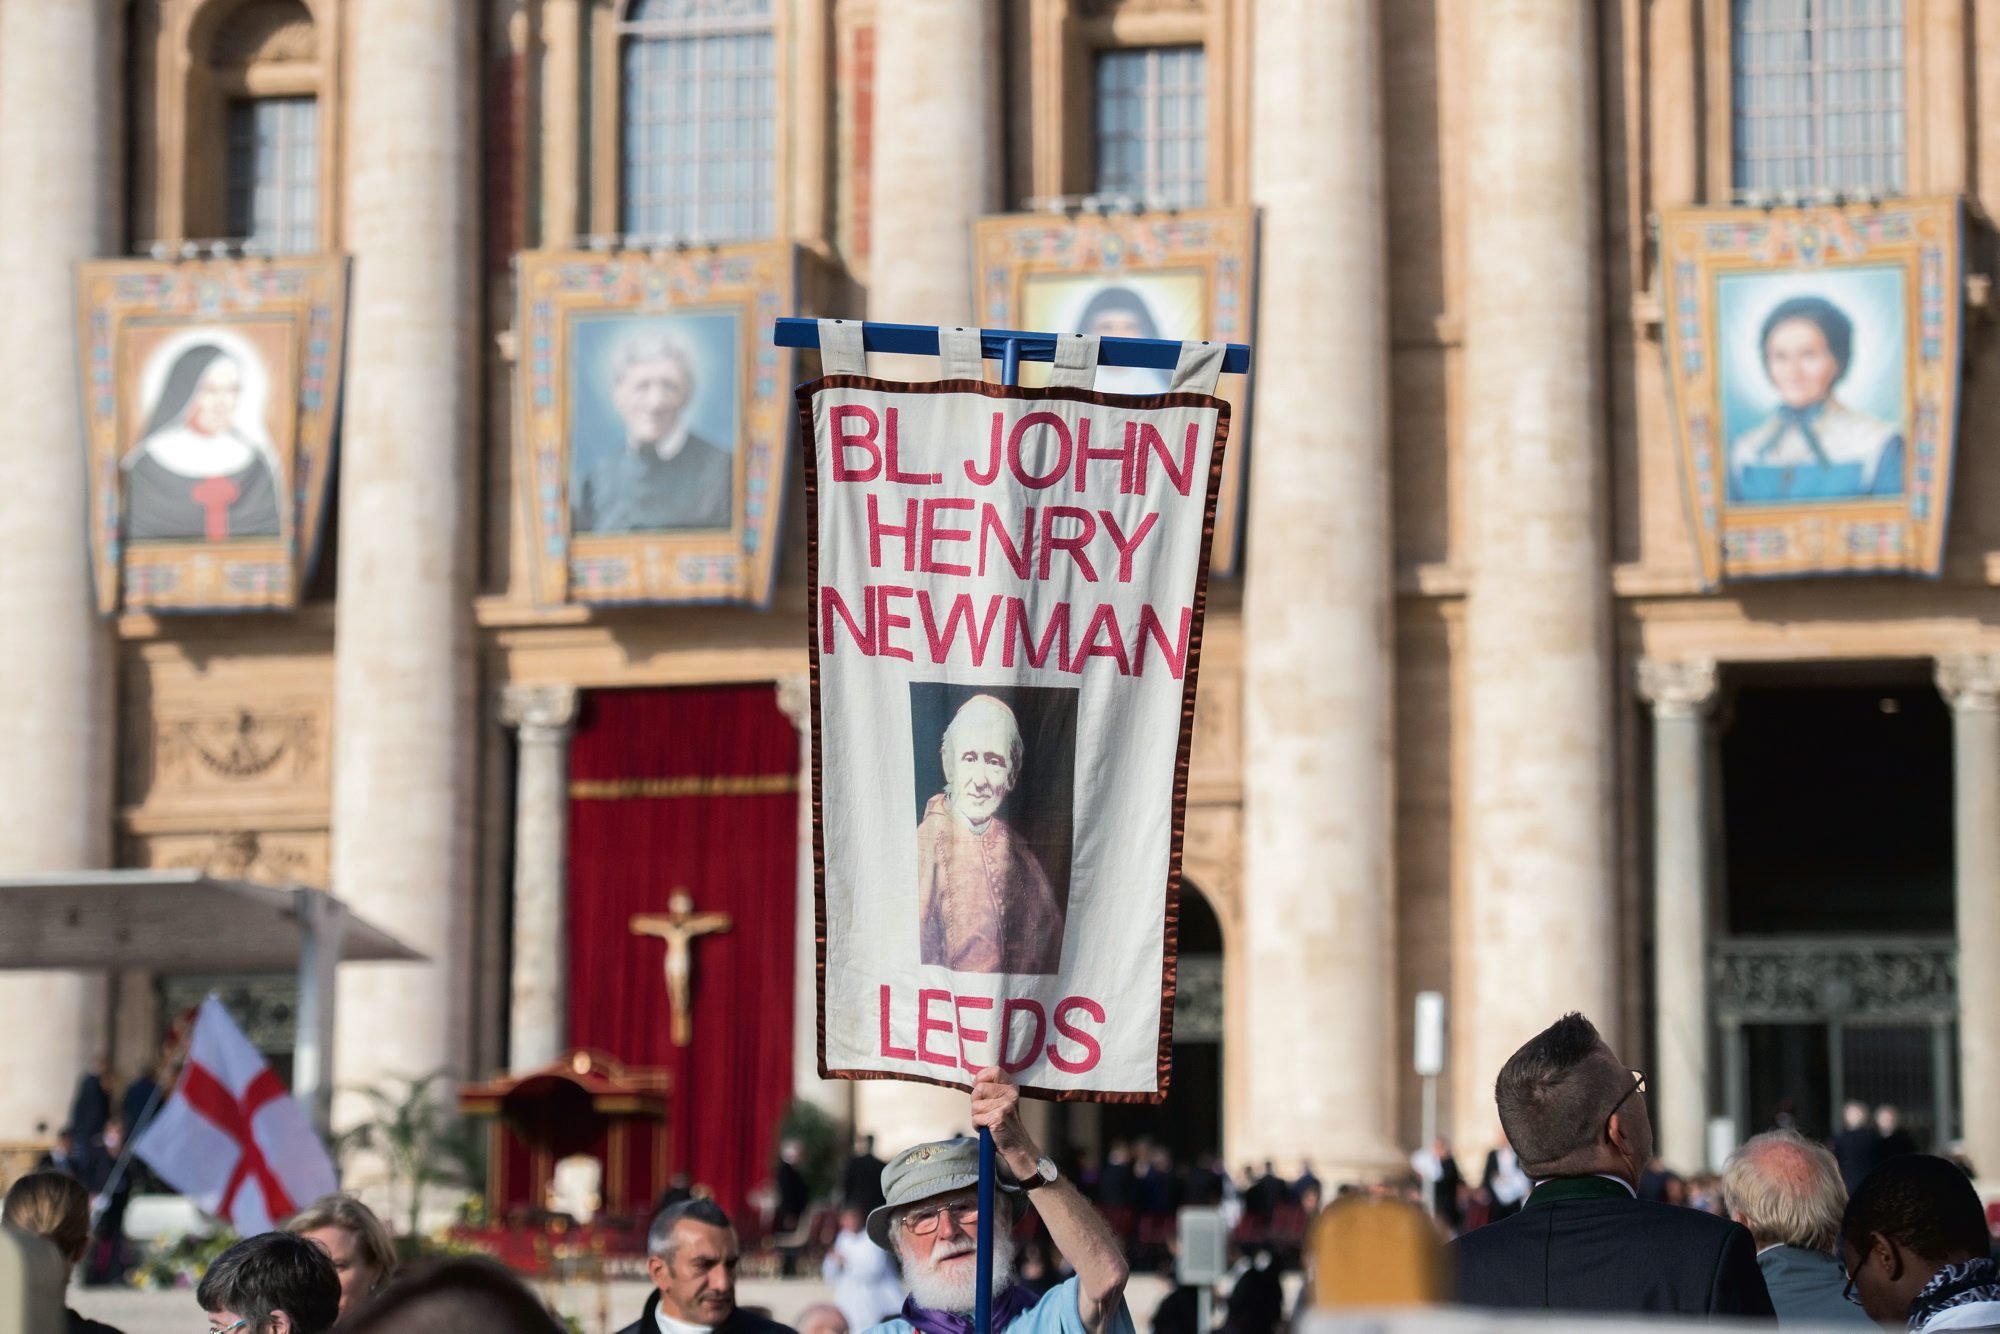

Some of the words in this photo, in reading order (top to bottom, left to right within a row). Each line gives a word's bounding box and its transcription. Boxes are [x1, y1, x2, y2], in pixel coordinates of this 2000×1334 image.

[829, 404, 943, 485] BL.
[963, 411, 1199, 496] JOHN
[866, 493, 1159, 583] HENRY
[820, 585, 1193, 680] NEWMAN
[880, 984, 1106, 1075] LEEDS
